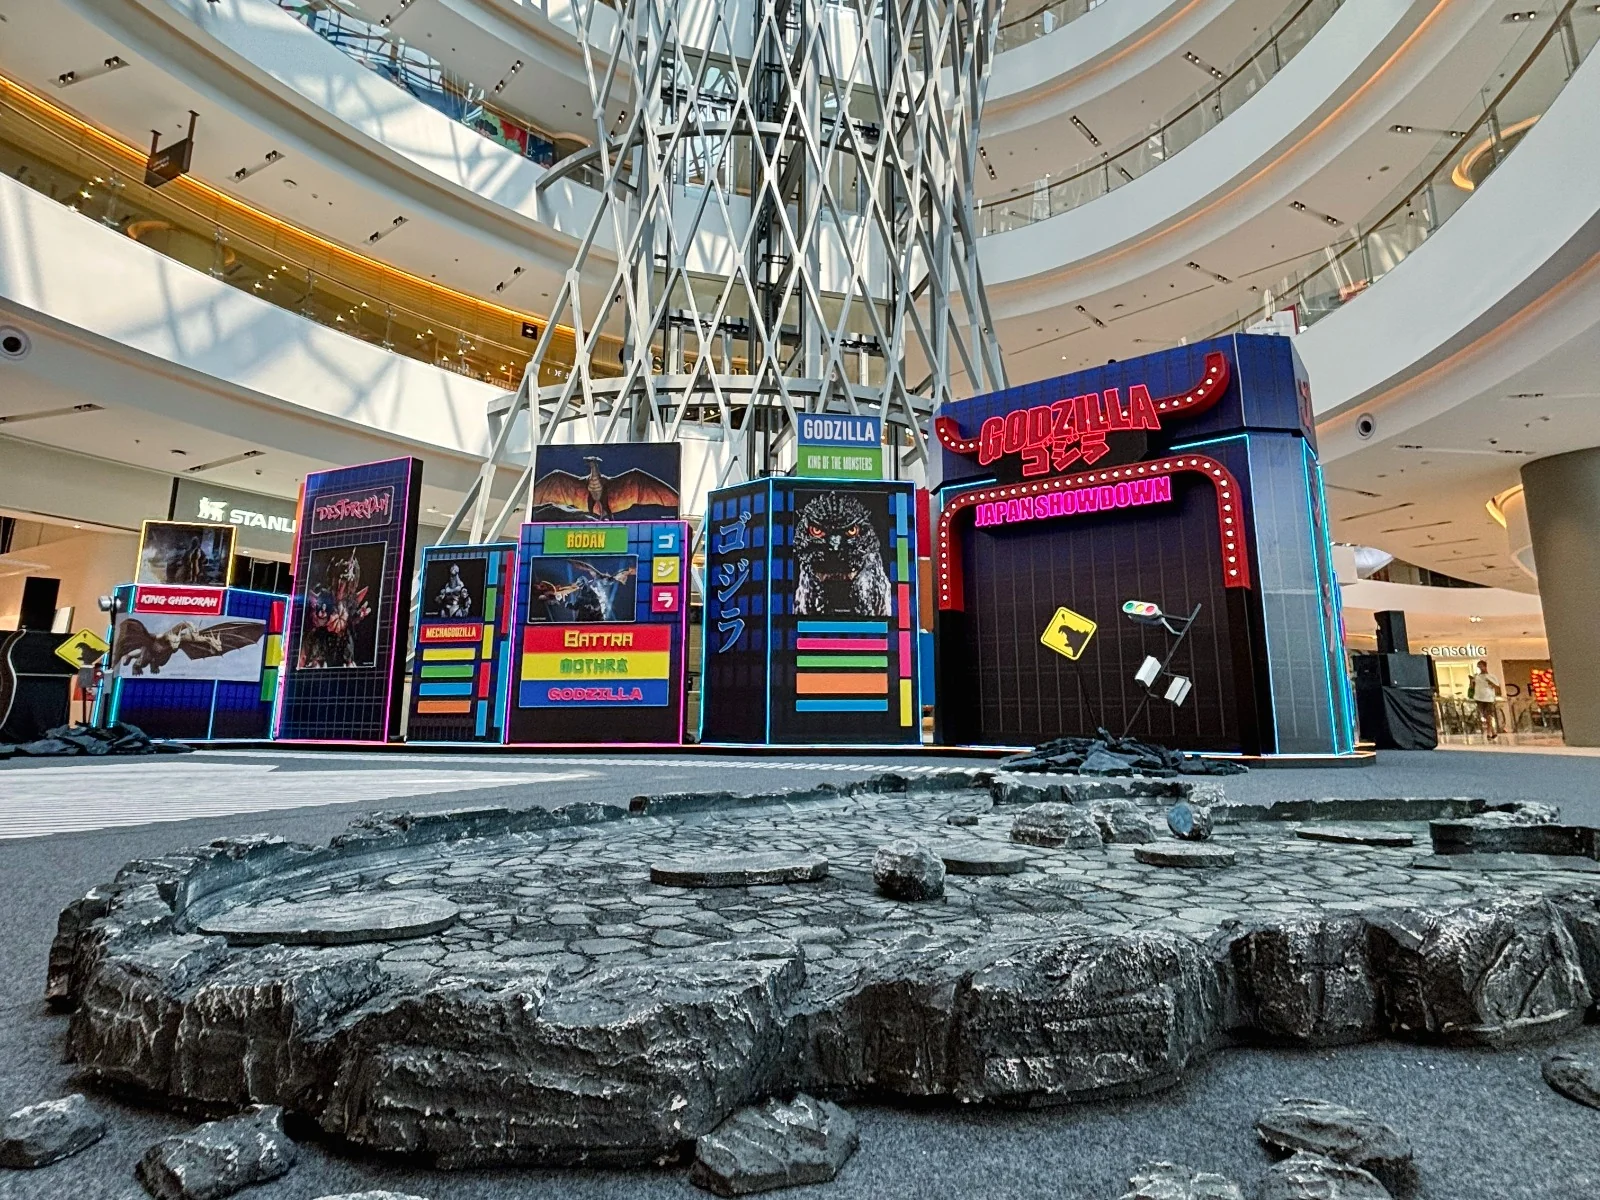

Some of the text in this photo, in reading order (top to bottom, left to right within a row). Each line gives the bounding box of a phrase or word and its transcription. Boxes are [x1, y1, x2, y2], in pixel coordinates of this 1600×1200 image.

[803, 419, 875, 441] GODZILLA
[979, 384, 1161, 466] GODZILLA
[807, 455, 873, 471] KING OF THE MONSTERS
[1022, 432, 1110, 476] ゴジラ
[975, 476, 1171, 526] JAPAN SHOWDOWN
[567, 531, 606, 549] RODAN
[718, 511, 752, 653] ゴジラ
[141, 595, 218, 607] KING GHIDORAH
[426, 626, 476, 638] MECHAGODZILLA
[560, 657, 628, 674] MOTHRA
[548, 687, 643, 701] GODZILLA
